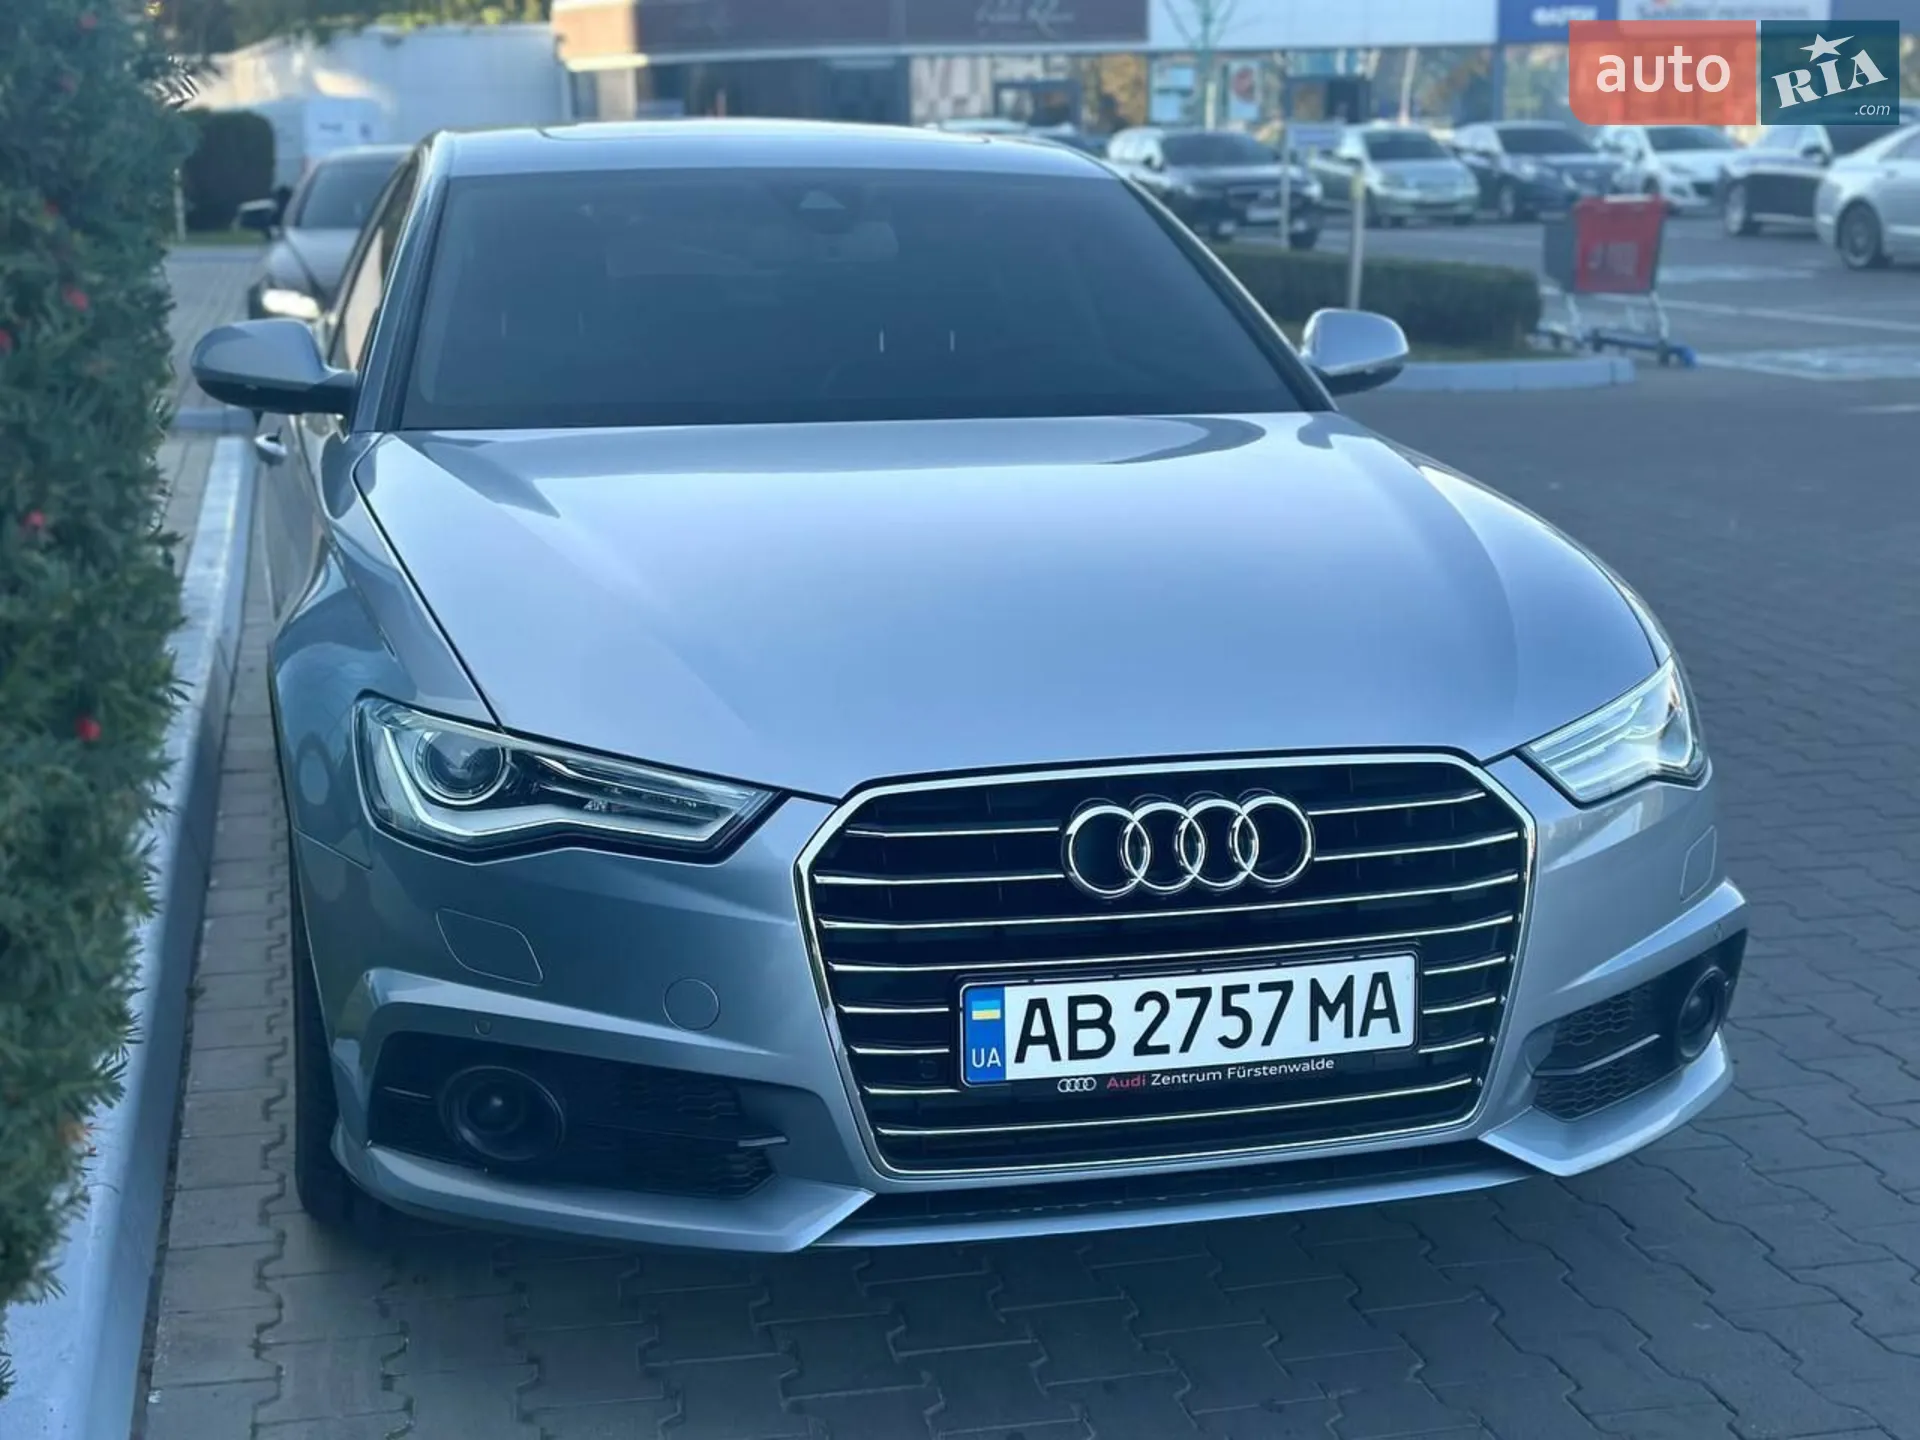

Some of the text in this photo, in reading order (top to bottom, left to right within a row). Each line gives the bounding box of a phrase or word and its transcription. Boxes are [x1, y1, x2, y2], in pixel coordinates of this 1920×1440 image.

[1013, 971, 1401, 1064] AB 2757 MA
[971, 1047, 1002, 1069] UA
[1106, 1057, 1335, 1090] Audi Zentrum Fürstenwalde
